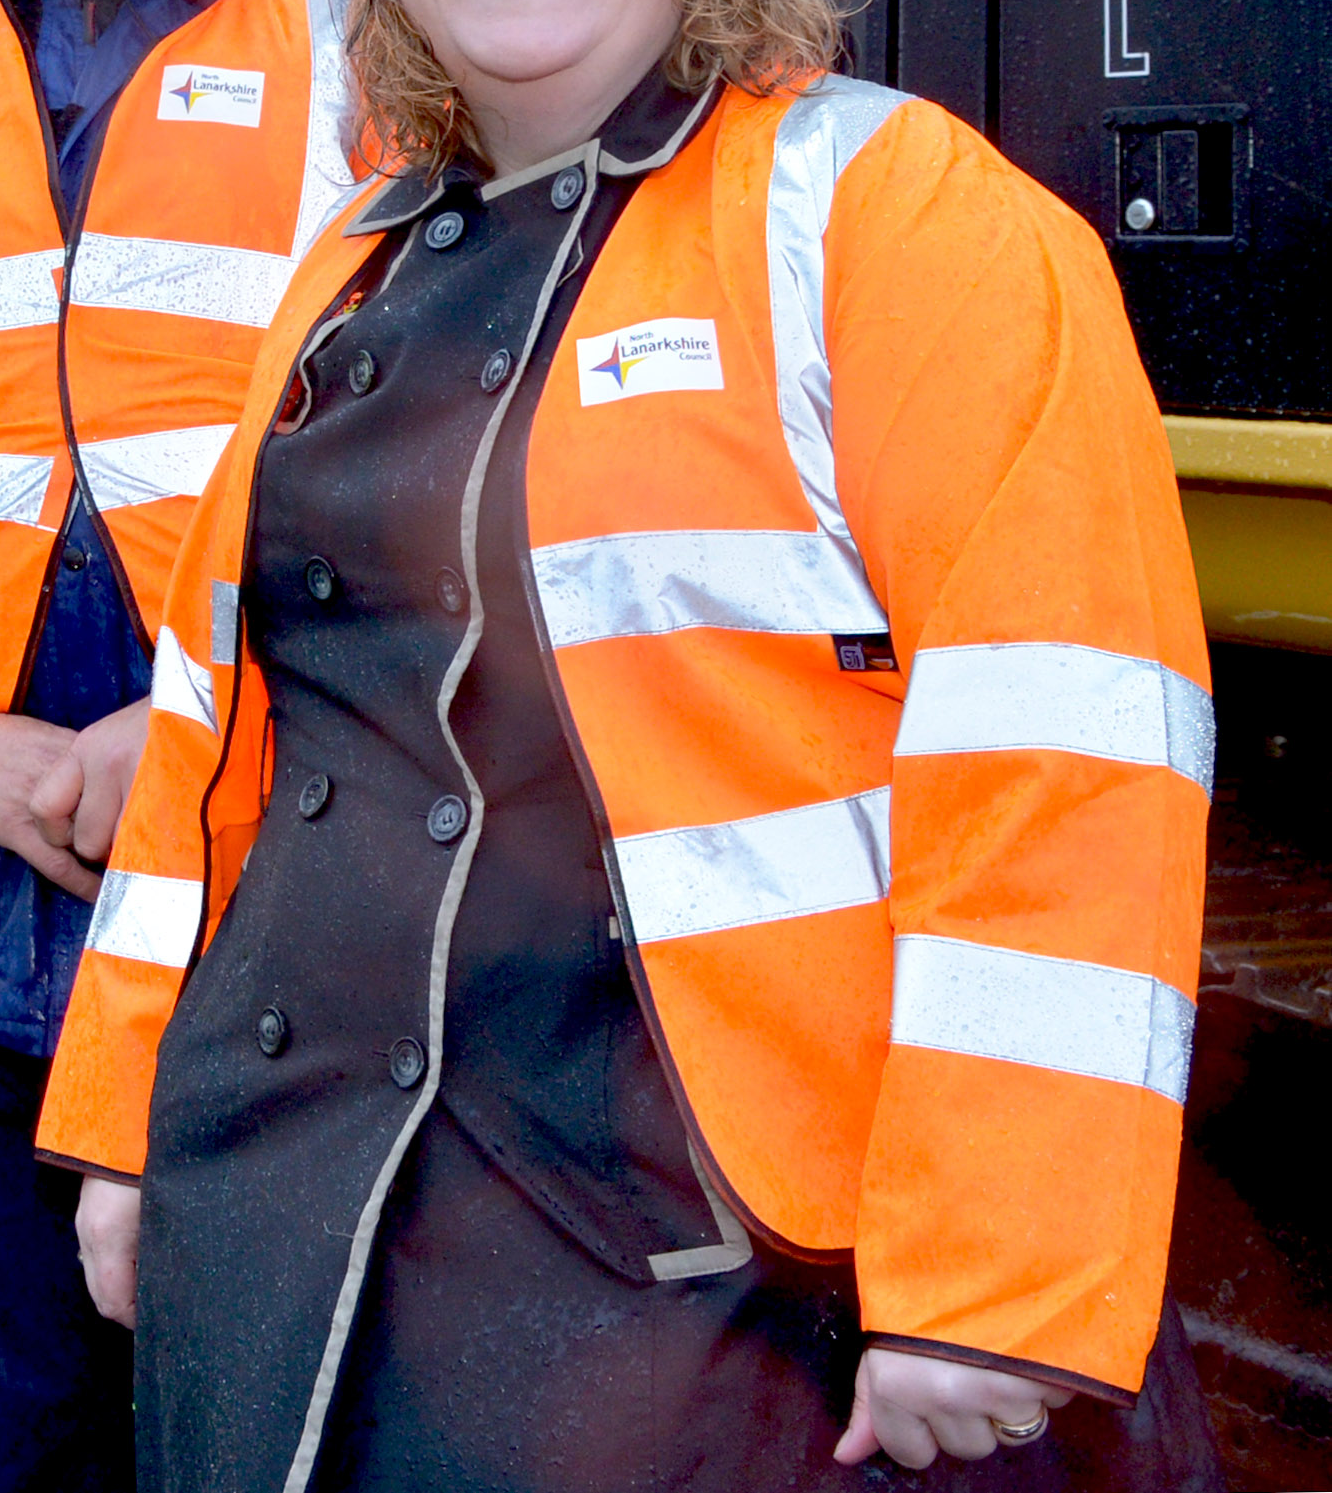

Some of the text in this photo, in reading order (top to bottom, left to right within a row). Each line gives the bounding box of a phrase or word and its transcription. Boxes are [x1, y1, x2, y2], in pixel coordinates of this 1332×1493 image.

[193, 80, 257, 96] Lanarkshire
[629, 331, 654, 342] North
[621, 337, 710, 358] Lanarkshire
[679, 352, 712, 361] Council
